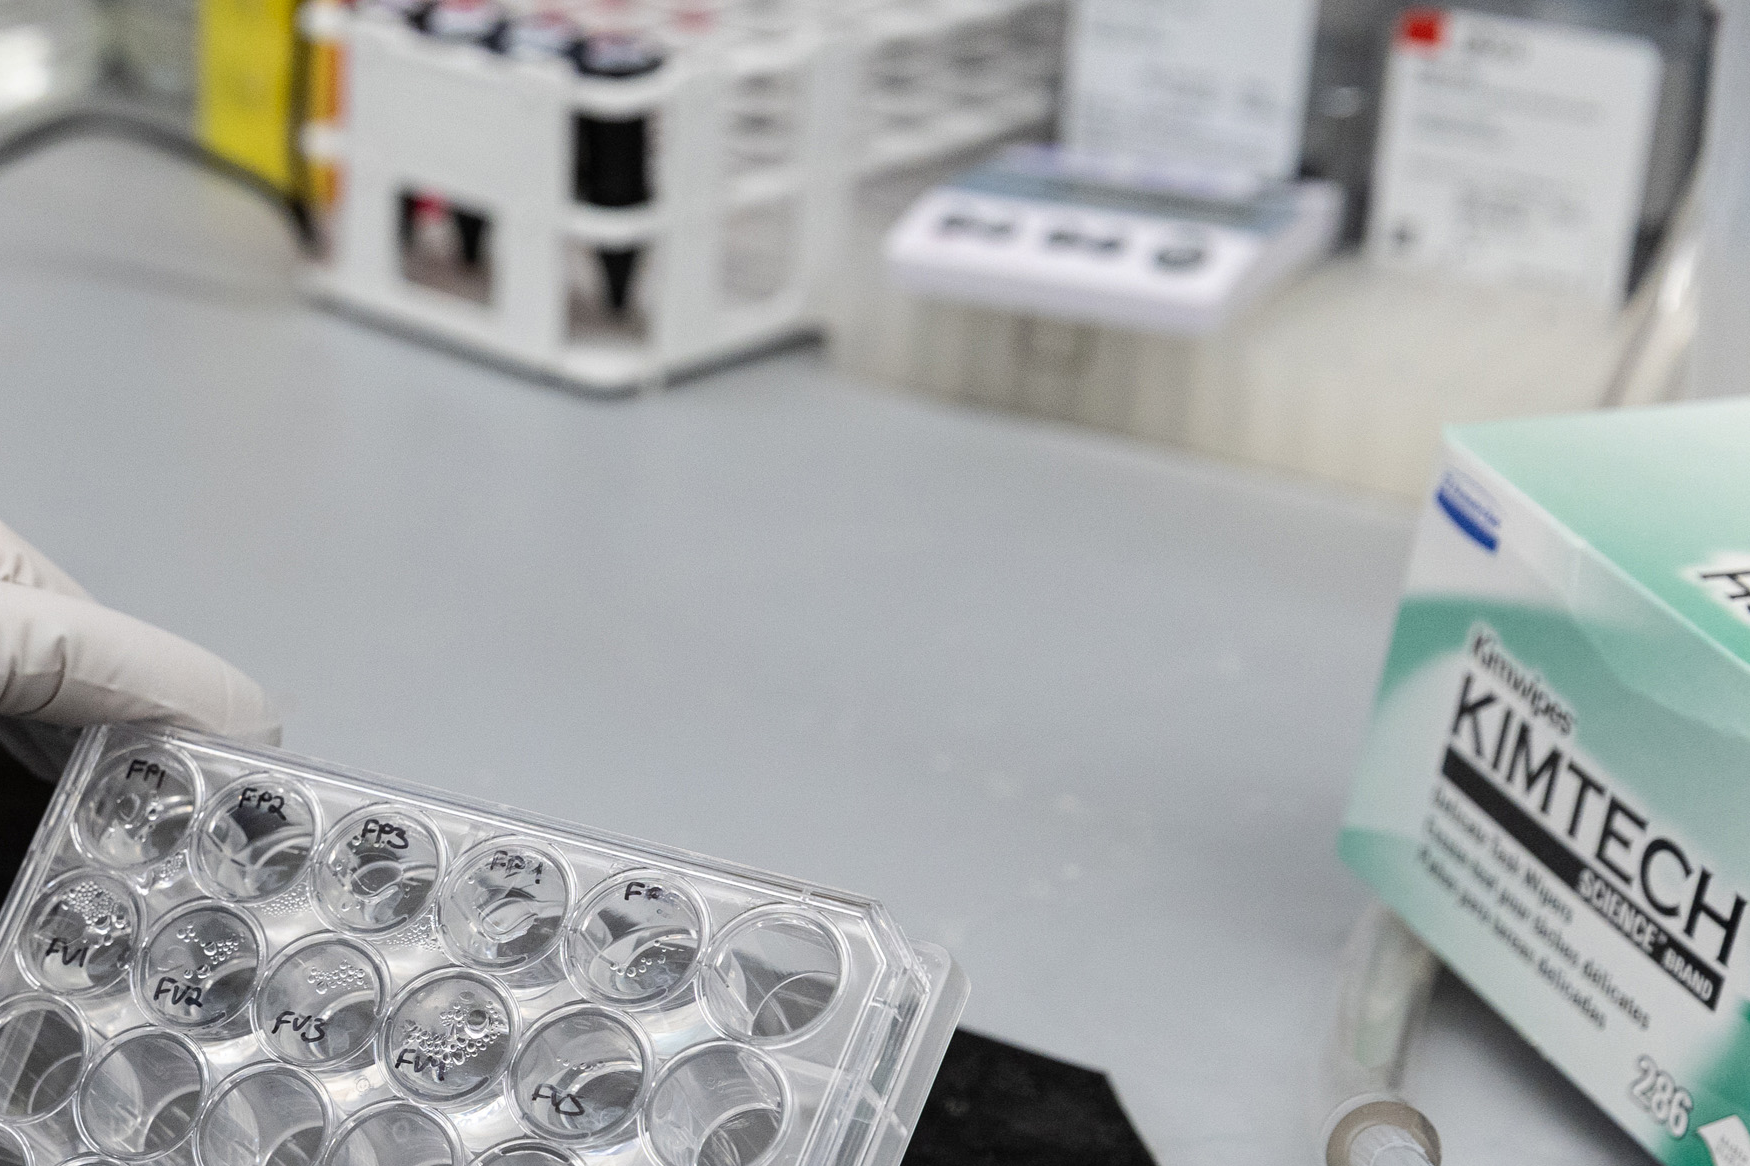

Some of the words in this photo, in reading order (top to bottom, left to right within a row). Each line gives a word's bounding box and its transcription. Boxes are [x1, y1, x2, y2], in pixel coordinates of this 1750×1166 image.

[1472, 633, 1574, 736] Kimwipes
[125, 759, 166, 789] FP1
[238, 787, 287, 821] FP2
[1451, 671, 1747, 967] KIMTECH
[360, 818, 410, 849] FP3
[45, 936, 91, 968] FV1
[1664, 947, 1714, 1002] BRAND
[153, 976, 204, 1008] FV2
[271, 1010, 328, 1043] FV3
[1628, 1053, 1694, 1141] 286
